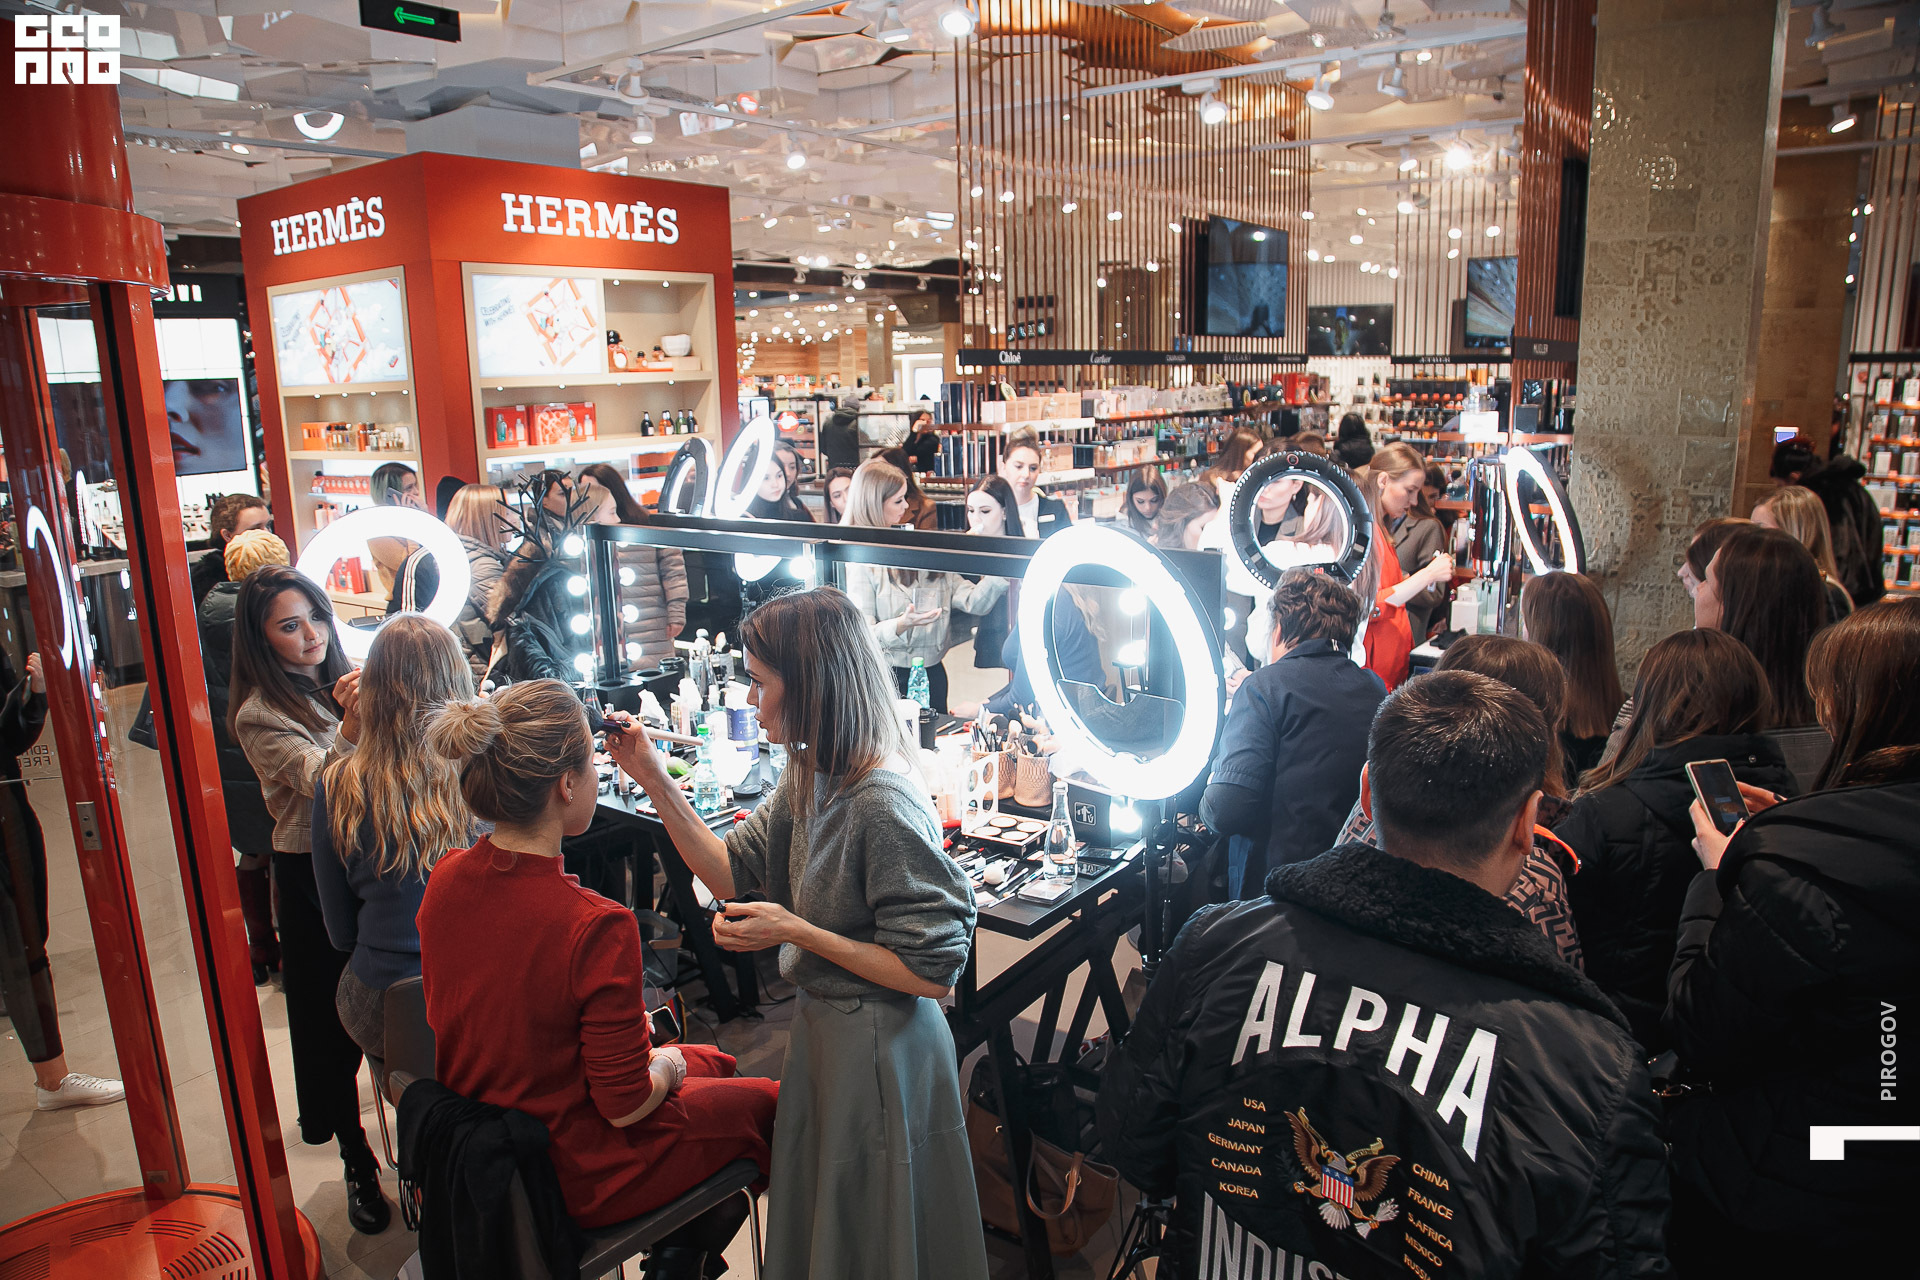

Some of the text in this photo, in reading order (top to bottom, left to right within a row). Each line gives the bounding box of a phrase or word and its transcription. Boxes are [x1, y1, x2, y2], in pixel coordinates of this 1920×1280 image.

[271, 196, 385, 255] HERMÈS
[502, 192, 679, 244] HERMÈS
[999, 350, 1021, 364] Chloé
[1231, 961, 1498, 1162] ALPHA
[1243, 1097, 1267, 1112] USA
[1227, 1118, 1265, 1135] JAPAN
[1208, 1130, 1264, 1154] GERMANY
[1211, 1157, 1262, 1177] CANADA
[1411, 1163, 1450, 1191] CHINA
[1219, 1181, 1259, 1199] KOREA
[1408, 1186, 1454, 1221] FRANCE
[1407, 1212, 1454, 1252] S.AFRICA
[1405, 1232, 1443, 1267] MEXICO
